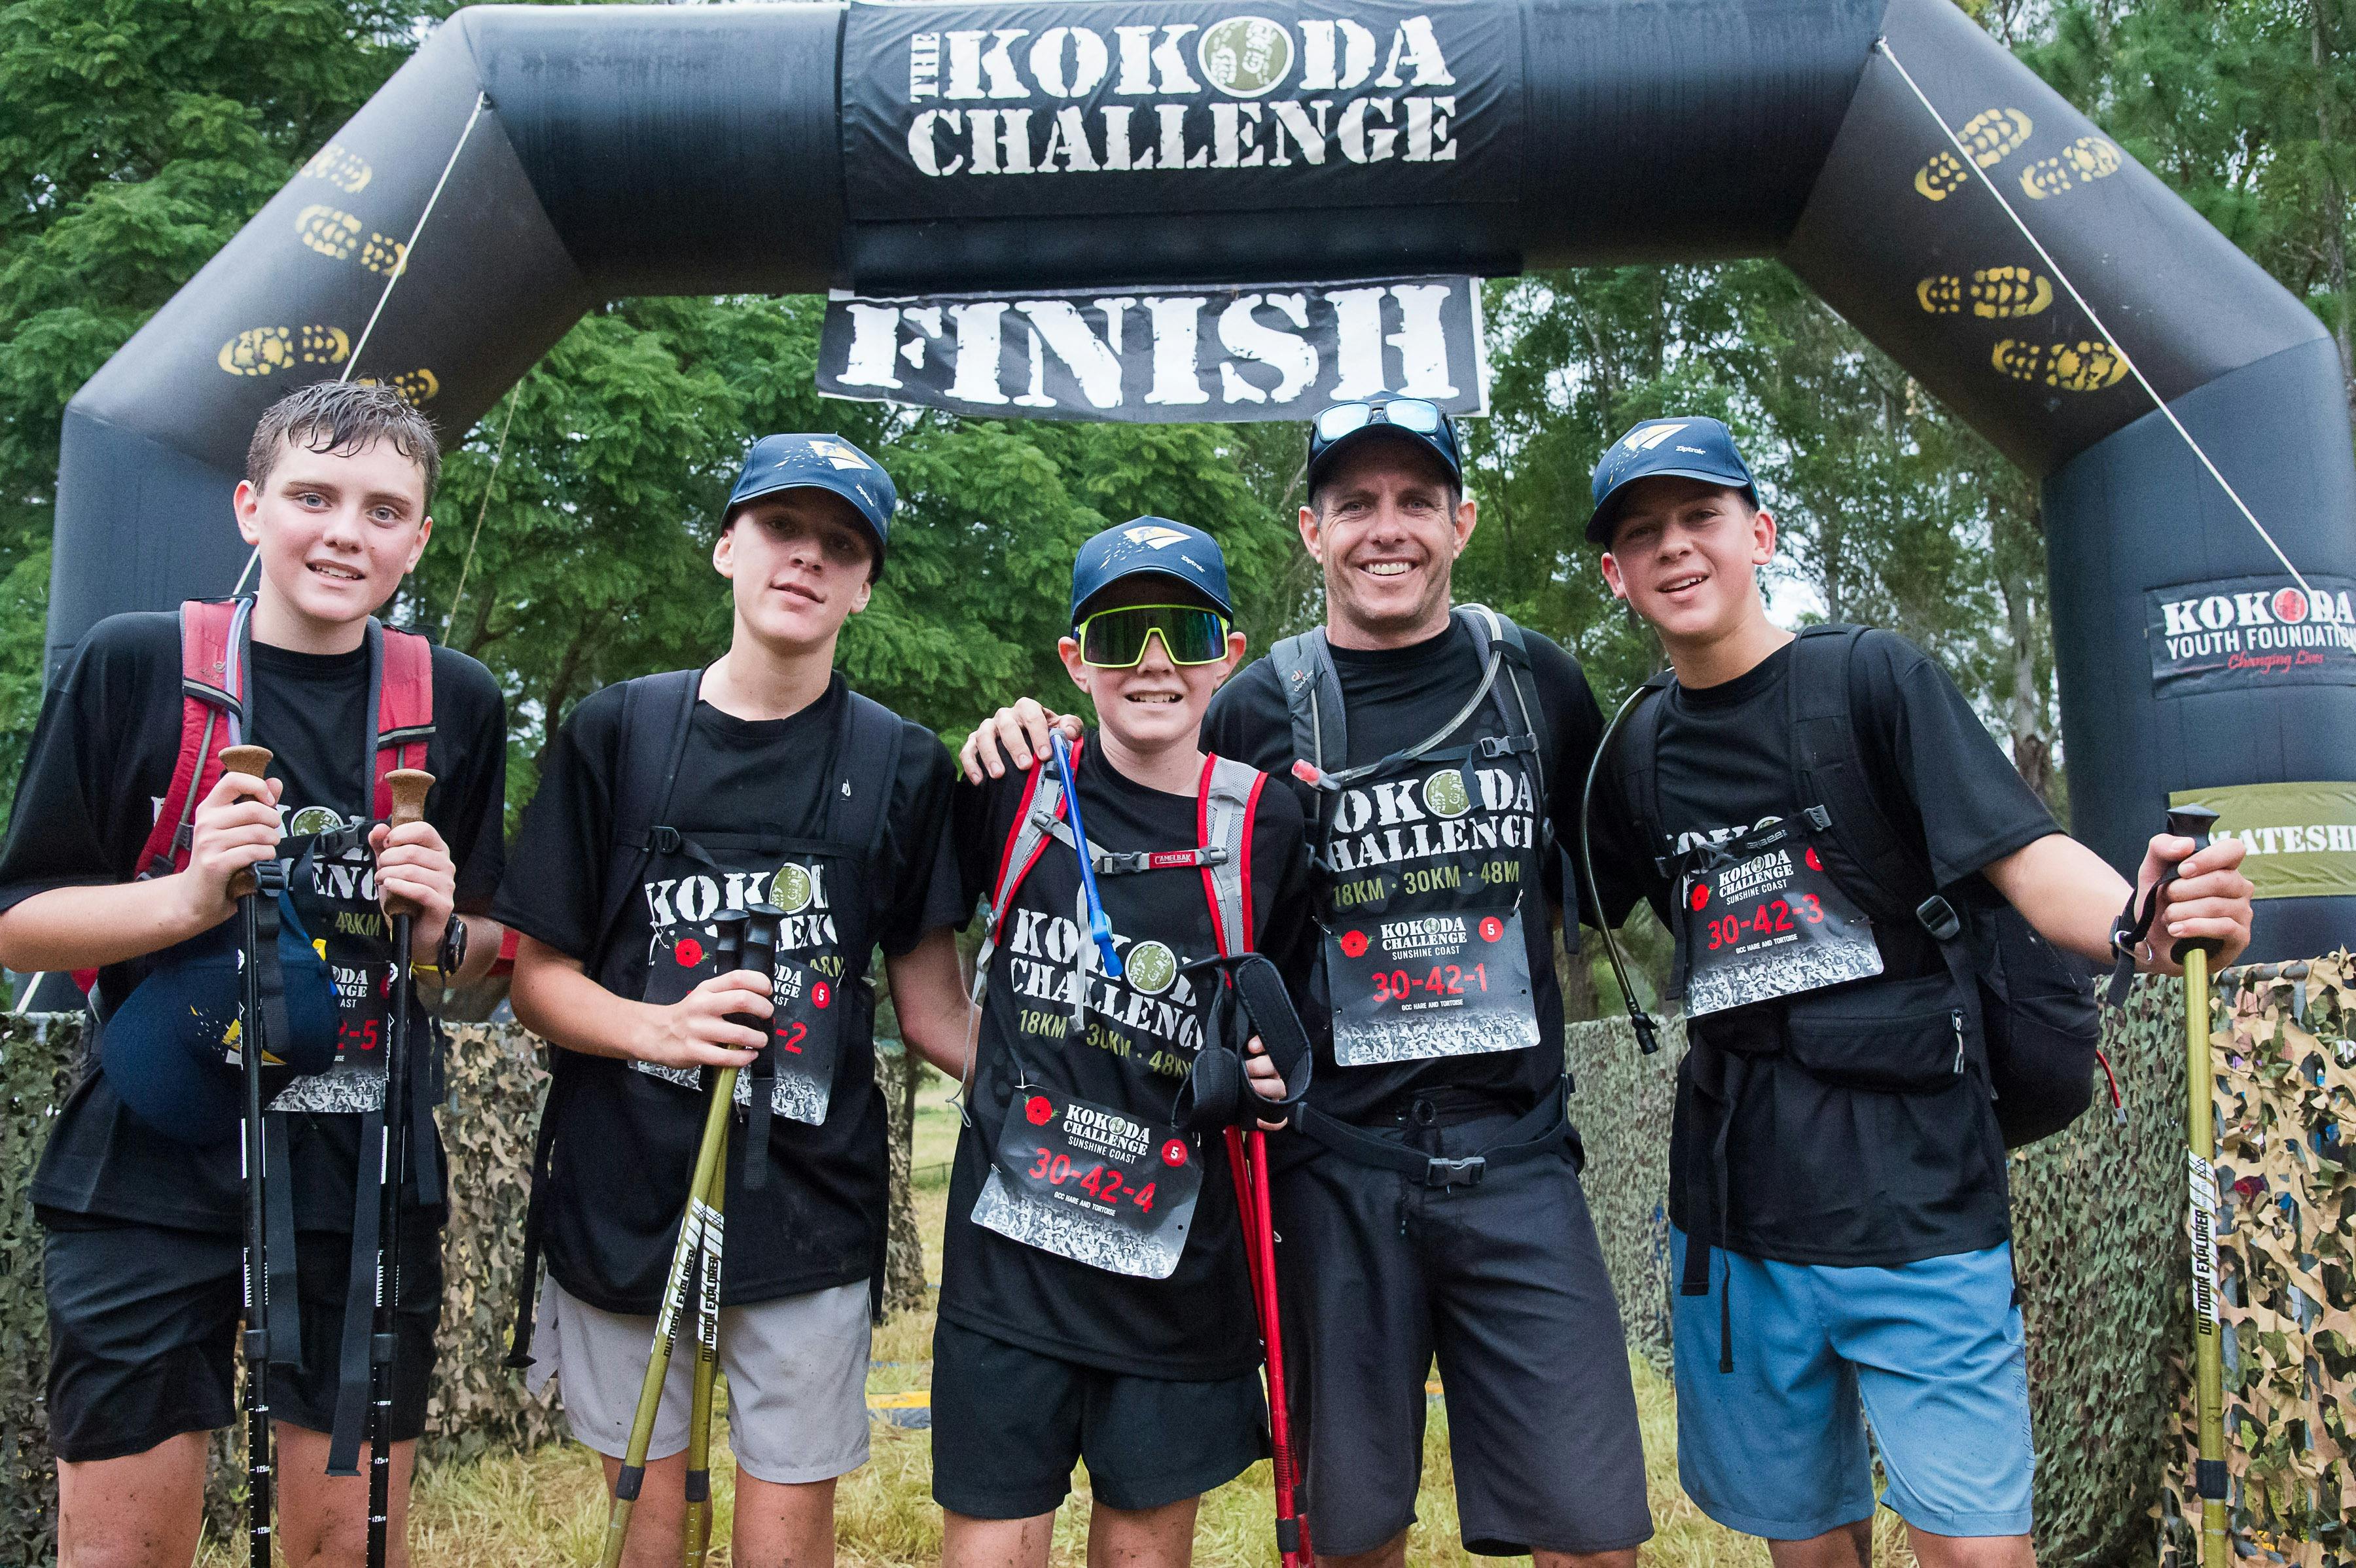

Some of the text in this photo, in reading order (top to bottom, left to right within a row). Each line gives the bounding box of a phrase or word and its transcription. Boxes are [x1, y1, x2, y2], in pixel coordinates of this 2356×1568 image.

[910, 32, 940, 103] THE
[944, 16, 1455, 99] KOKODA
[908, 96, 1458, 177] CHALLENGE
[836, 284, 1460, 409] FINISH
[2162, 586, 2355, 637] KOKODA
[2166, 629, 2240, 660] YOUTH
[1334, 768, 1534, 833] OKODA
[1155, 854, 1191, 864] CAMELBAK
[1719, 849, 1791, 887] KOKODA
[1333, 878, 1385, 907] 18KM
[1403, 865, 1461, 895] 30KM
[1719, 864, 1794, 898] CHALLENGE
[1726, 879, 1787, 905] SUNSHINE COAST
[334, 911, 381, 936] 48KM
[1380, 917, 1466, 938] KOKODA
[1487, 923, 1495, 936] 5
[1708, 893, 1825, 950] 30-42-3
[1382, 932, 1467, 951] CHALLENGE
[1392, 946, 1460, 961] SUNSHINE COAST
[1747, 942, 1761, 951] HARE
[1762, 939, 1773, 948] AND
[1774, 934, 1798, 945] TORTOISE
[818, 989, 825, 1001] 5
[1372, 963, 1488, 1002] 30-42-1
[340, 999, 357, 1008] AST
[774, 995, 789, 1007] AST
[1440, 999, 1463, 1007] TORTOISE
[1020, 1009, 1067, 1039] 18KM
[1063, 1120, 1149, 1156] CHALLENGE
[1066, 1103, 1150, 1144] KOKODA
[1068, 1135, 1137, 1165] SUNSHINE COAST
[1170, 1147, 1179, 1160] 5
[1028, 1147, 1156, 1213] 30-42-4
[1054, 1191, 1116, 1217] GCC HARE AND TORTOISE
[2195, 1209, 2210, 1274] EXPLORER
[2198, 1275, 2212, 1336] OUTDOOR
[702, 1313, 716, 1362] OUTDOOR
